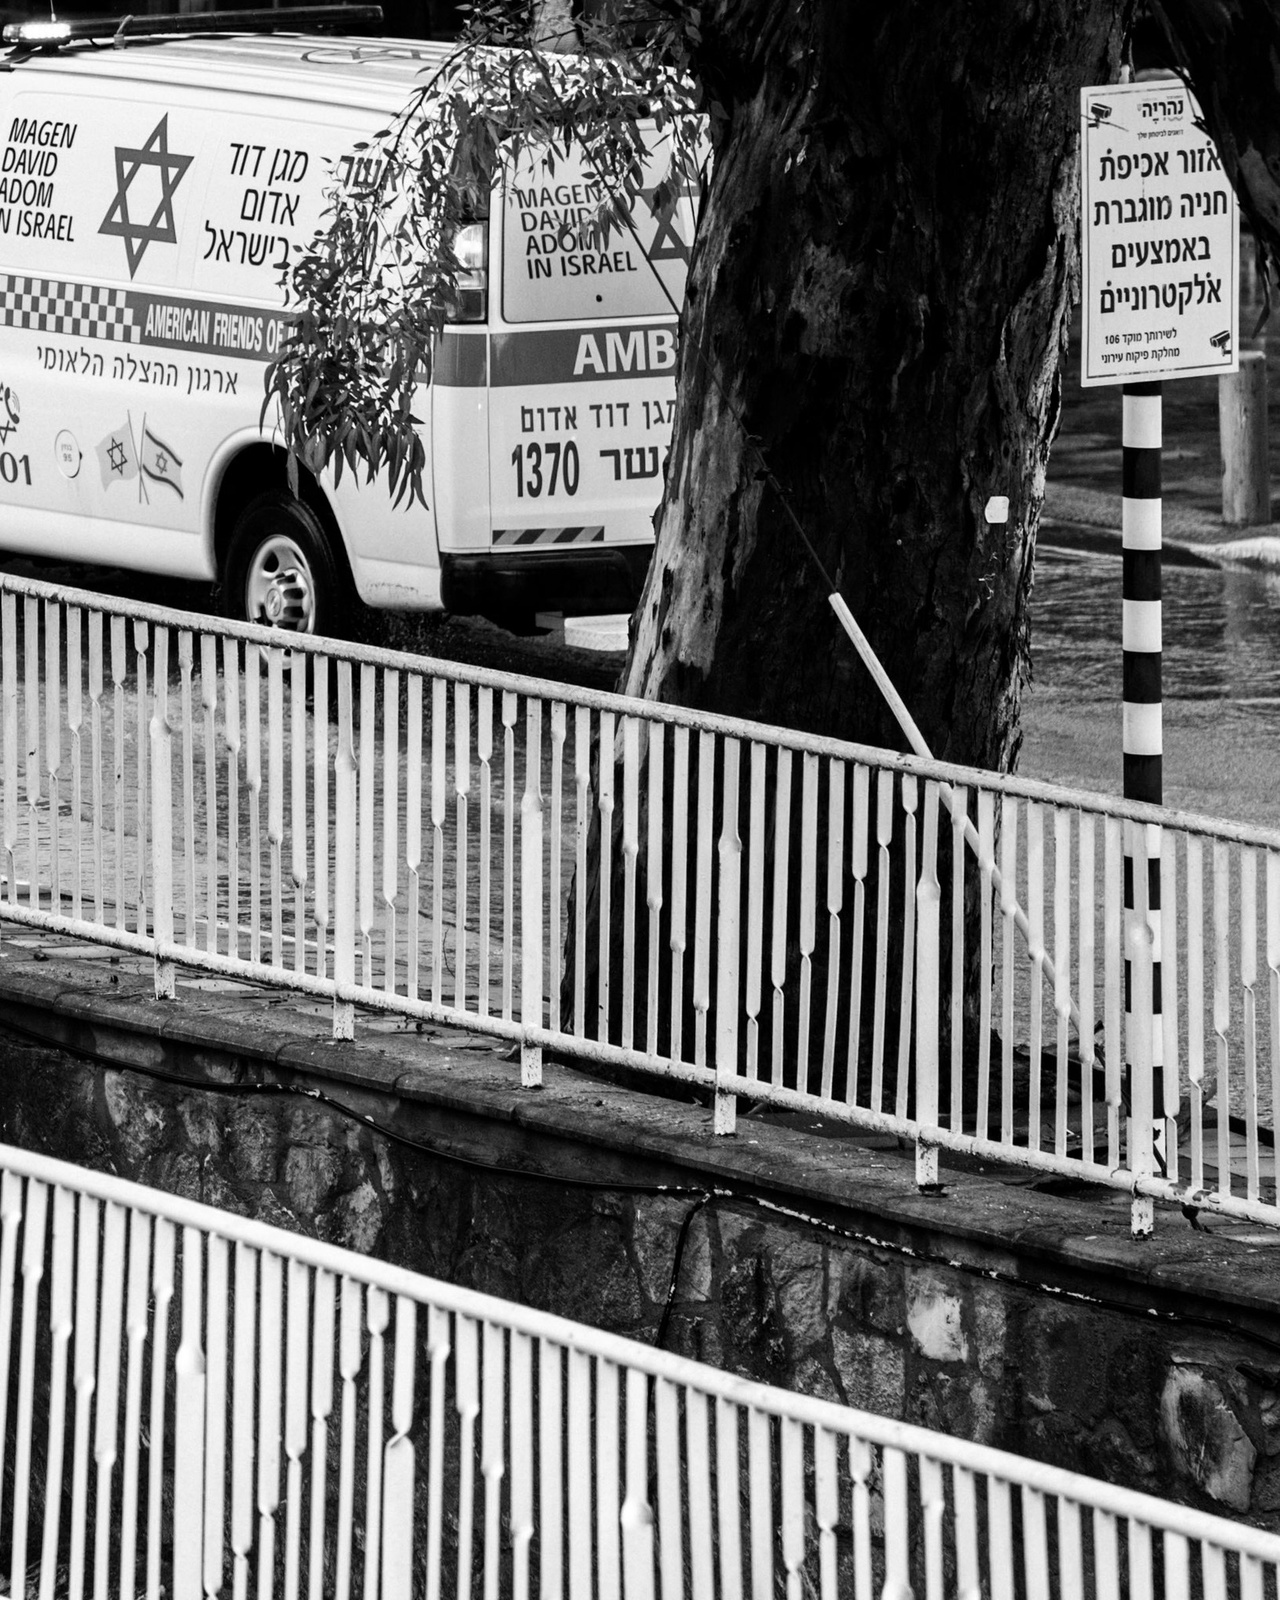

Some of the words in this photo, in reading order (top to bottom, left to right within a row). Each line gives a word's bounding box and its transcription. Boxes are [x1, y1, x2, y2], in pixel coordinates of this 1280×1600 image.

[8, 117, 78, 149] MAGEN
[1, 146, 58, 177] DAVID
[230, 142, 267, 178] דוד
[267, 147, 309, 187] מגן
[1099, 150, 1170, 182] אכיפת
[1176, 146, 1222, 175] אזור
[240, 188, 300, 227] אדום
[516, 184, 601, 209] MAGEN
[1093, 194, 1173, 227] מוגברת
[1180, 189, 1228, 219] חניה
[16, 209, 75, 242] ISRAEL
[203, 219, 291, 268] בישראל
[1111, 235, 1212, 269] באמצעים
[526, 257, 552, 280] IN
[560, 250, 638, 277] ISRAEL
[1099, 273, 1223, 316] אלקטרוניים
[144, 303, 211, 345] AMERICAN
[213, 311, 264, 353] FRIENDS
[266, 318, 285, 354] OF
[1105, 334, 1120, 345] 106
[1122, 332, 1143, 346] מוקד
[1144, 327, 1178, 344] לשירותך
[36, 346, 104, 377] הלאומי
[1101, 353, 1124, 364] עירוני
[1125, 350, 1149, 364] פיקוח
[1151, 346, 1181, 362] מחלקת
[113, 353, 178, 387] ההצלה
[187, 365, 238, 395] ארגון
[520, 405, 578, 433] אדום
[588, 402, 630, 428] דוד
[511, 440, 580, 498] 1370
[599, 445, 670, 481] שר
